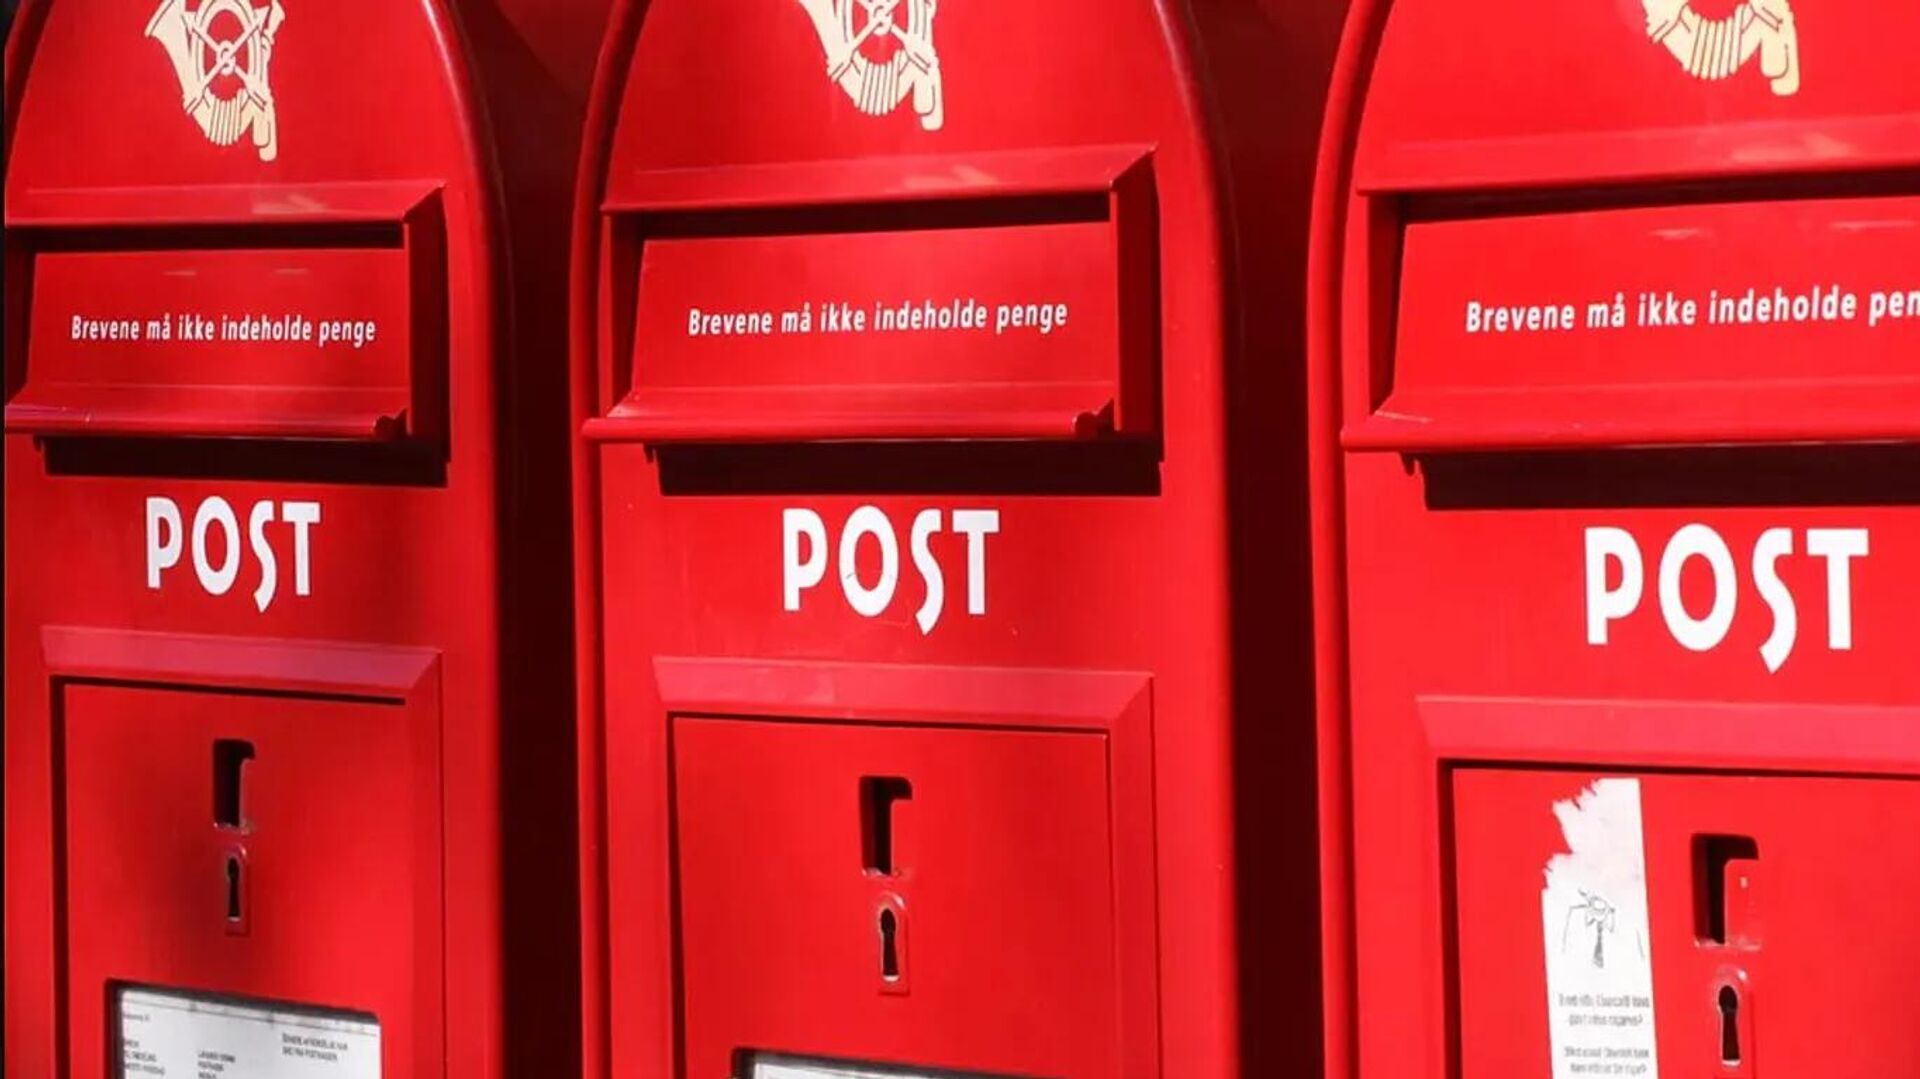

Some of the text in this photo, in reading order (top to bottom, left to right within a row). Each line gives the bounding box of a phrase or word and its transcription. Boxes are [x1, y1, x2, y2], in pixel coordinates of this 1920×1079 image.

[72, 313, 376, 347] Brevene må ikke indeholde penge
[688, 298, 1068, 336] Brevene må ikke indeholde penge
[1466, 301, 1575, 333] Brevene
[1586, 292, 1626, 328] må
[1637, 292, 1697, 326] ikke
[1708, 284, 1857, 324] indeholde
[146, 496, 321, 613] POST
[782, 505, 1000, 635] POST
[1584, 523, 1870, 675] POST
